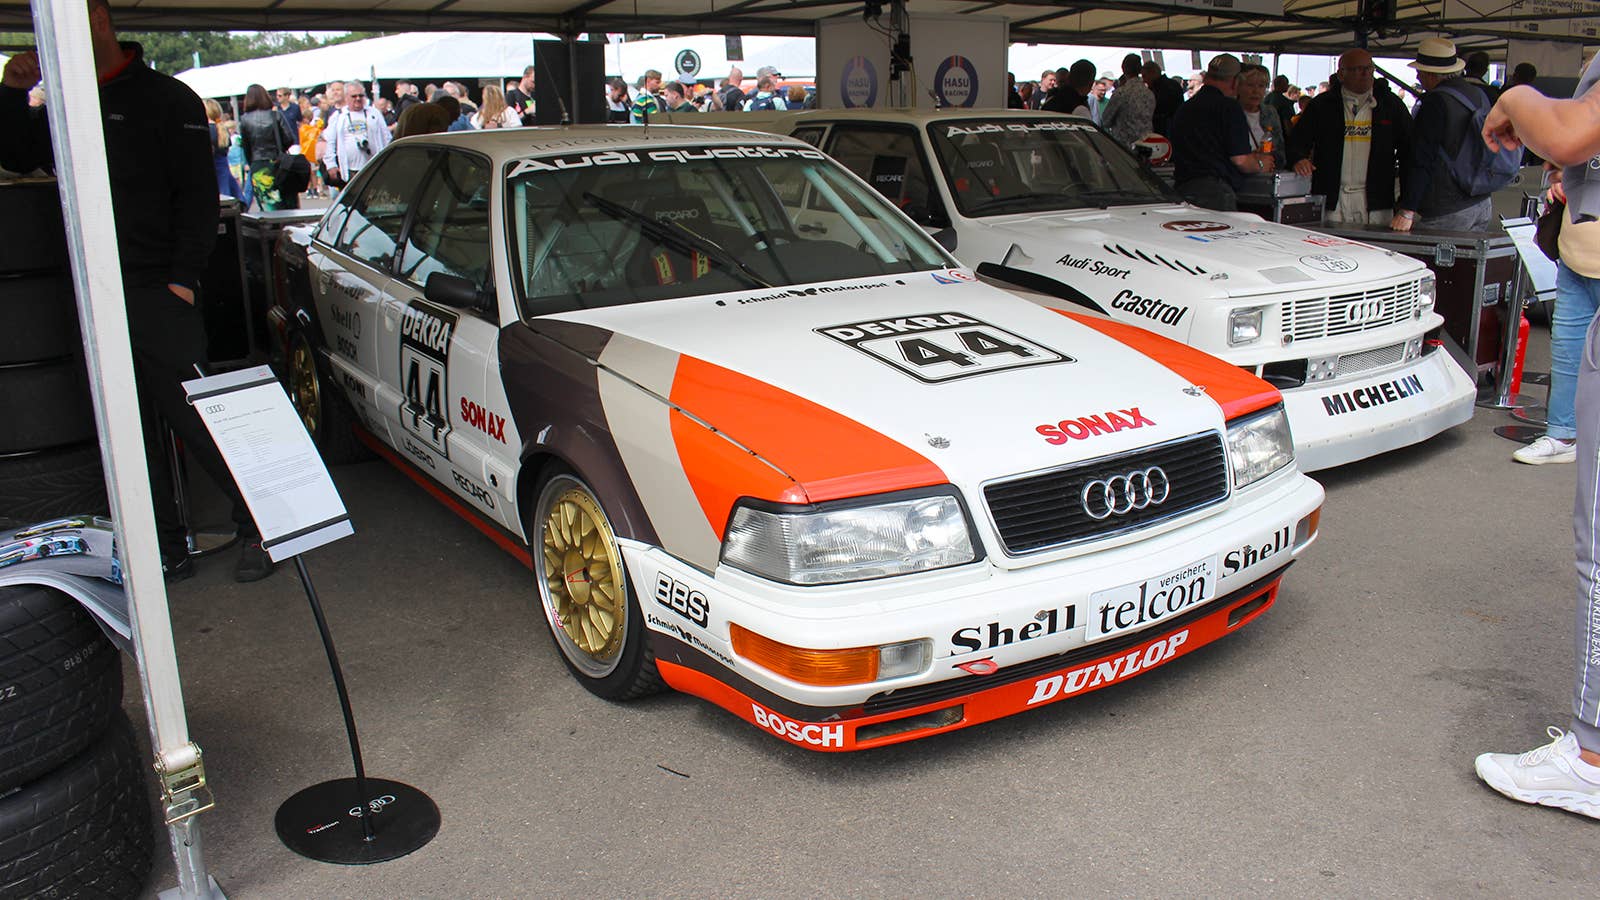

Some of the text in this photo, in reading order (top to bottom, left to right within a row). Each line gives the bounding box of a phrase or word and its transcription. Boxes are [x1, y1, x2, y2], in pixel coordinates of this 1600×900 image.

[944, 78, 969, 88] HASU
[946, 121, 1098, 138] Audi quattro
[506, 145, 826, 179] Audi quattro
[1056, 254, 1131, 280] Audi Sport
[738, 292, 790, 305] Schmidt
[1111, 289, 1189, 327] Castrol
[402, 305, 451, 355] DEKRA
[824, 313, 981, 342] DEKRA
[896, 330, 1040, 367] 44
[406, 357, 446, 446] 44
[1320, 374, 1425, 417] MICHELIN
[460, 396, 507, 445] SONAX
[1035, 407, 1157, 445] SONAX
[451, 469, 495, 510] RECARO
[1222, 526, 1290, 579] Shell
[1160, 562, 1206, 588] versichert
[655, 570, 710, 629] BBS
[1099, 581, 1205, 634] telcon
[950, 605, 1076, 656] Shell
[1027, 630, 1189, 705] DUNLOP
[751, 703, 844, 748] BOSCH
